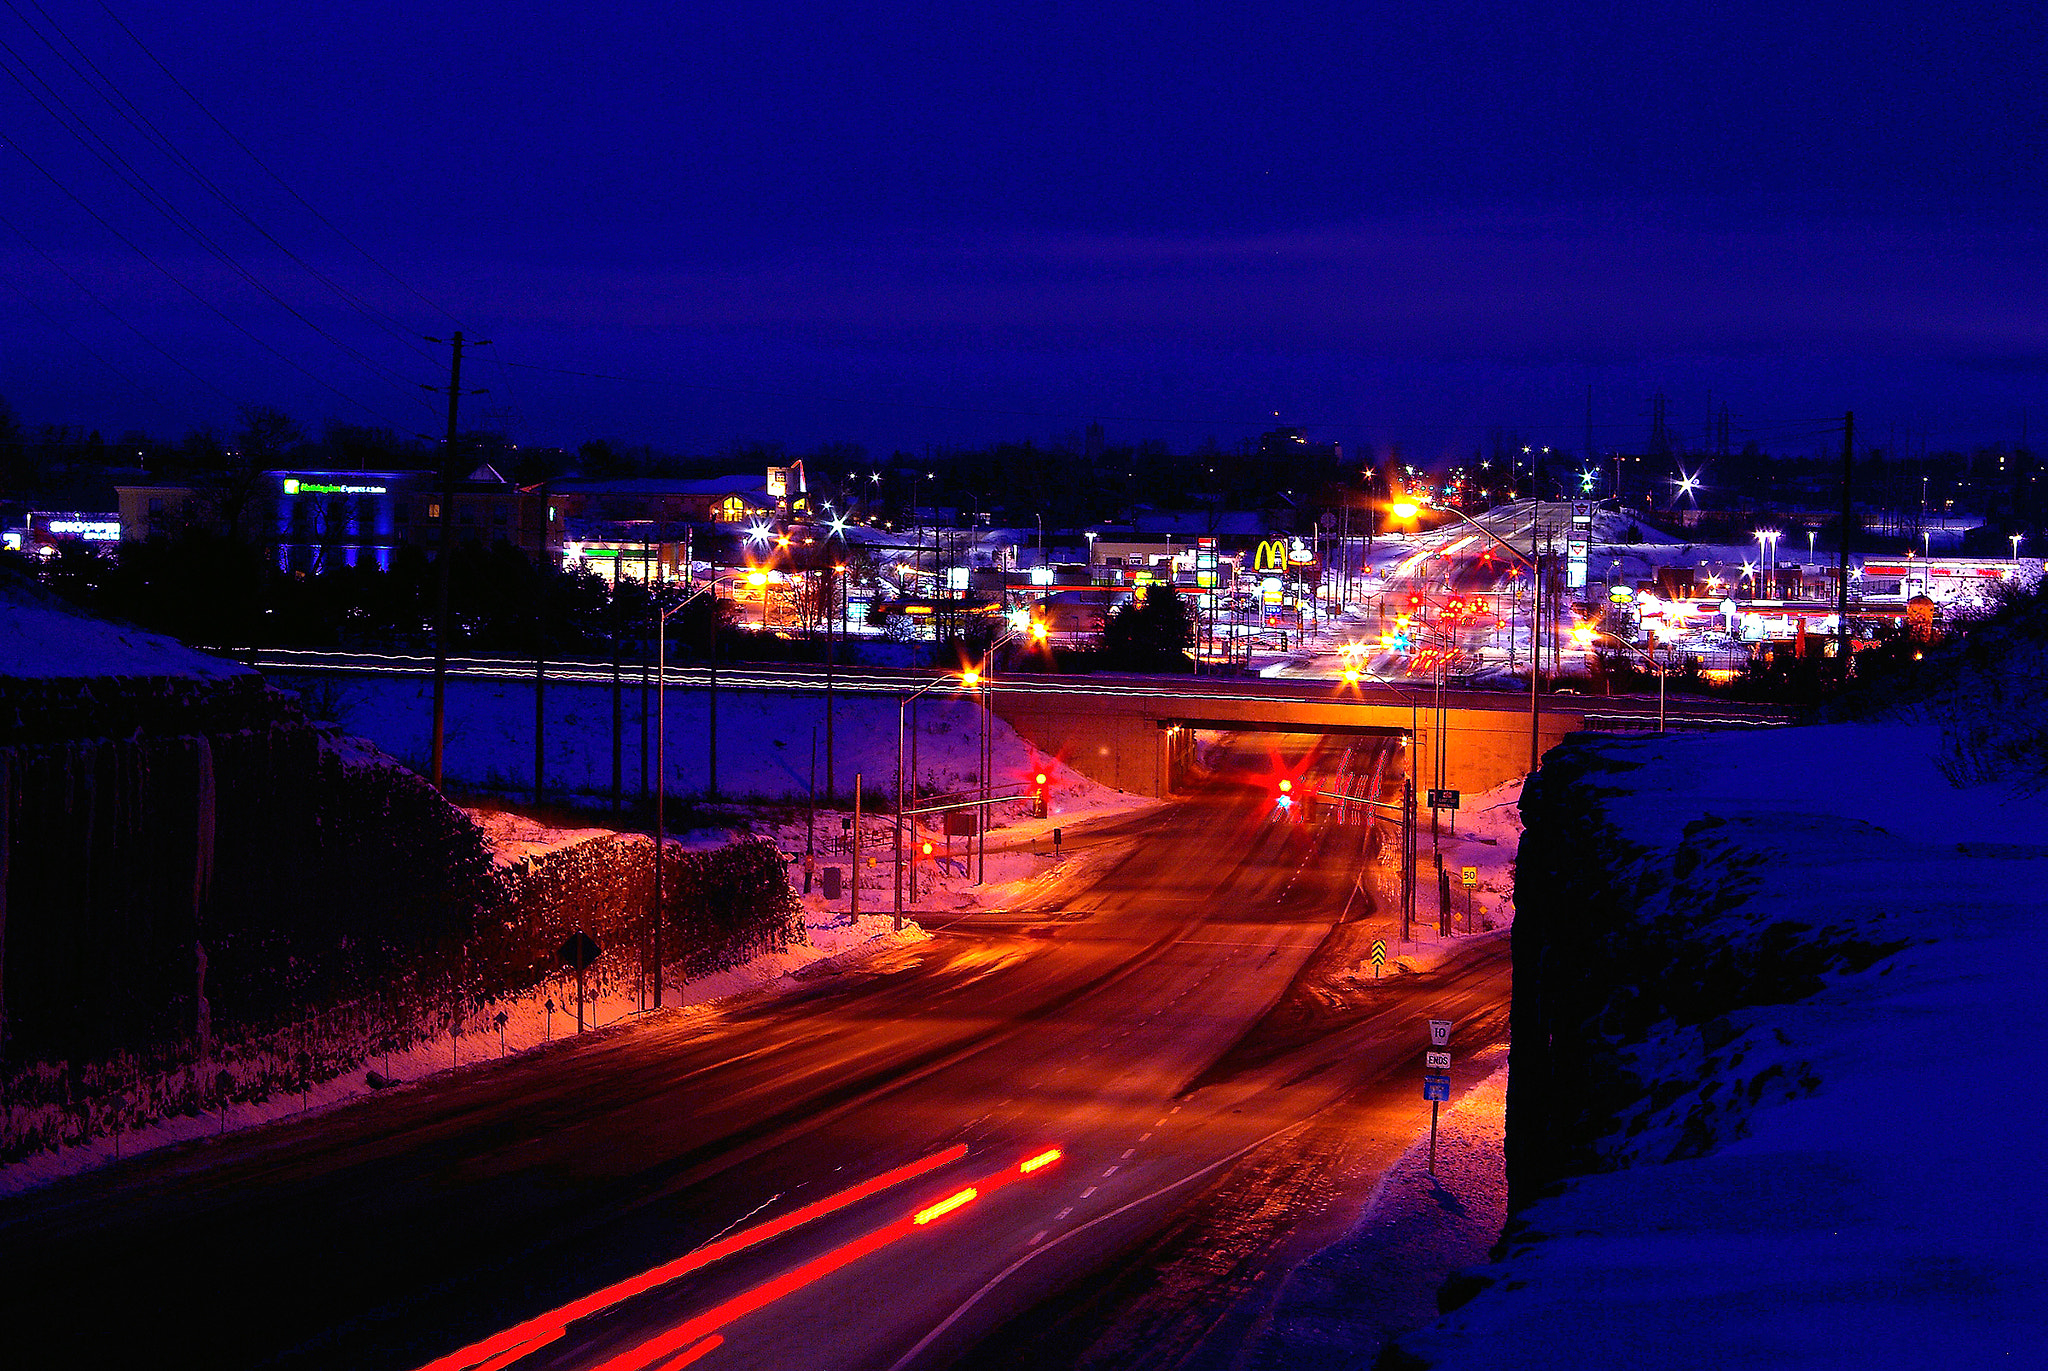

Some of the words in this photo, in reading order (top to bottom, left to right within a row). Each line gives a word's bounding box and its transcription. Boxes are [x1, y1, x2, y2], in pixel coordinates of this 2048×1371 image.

[1463, 871, 1476, 880] 50
[1434, 1027, 1446, 1038] 10
[1428, 1056, 1449, 1065] ENDS
